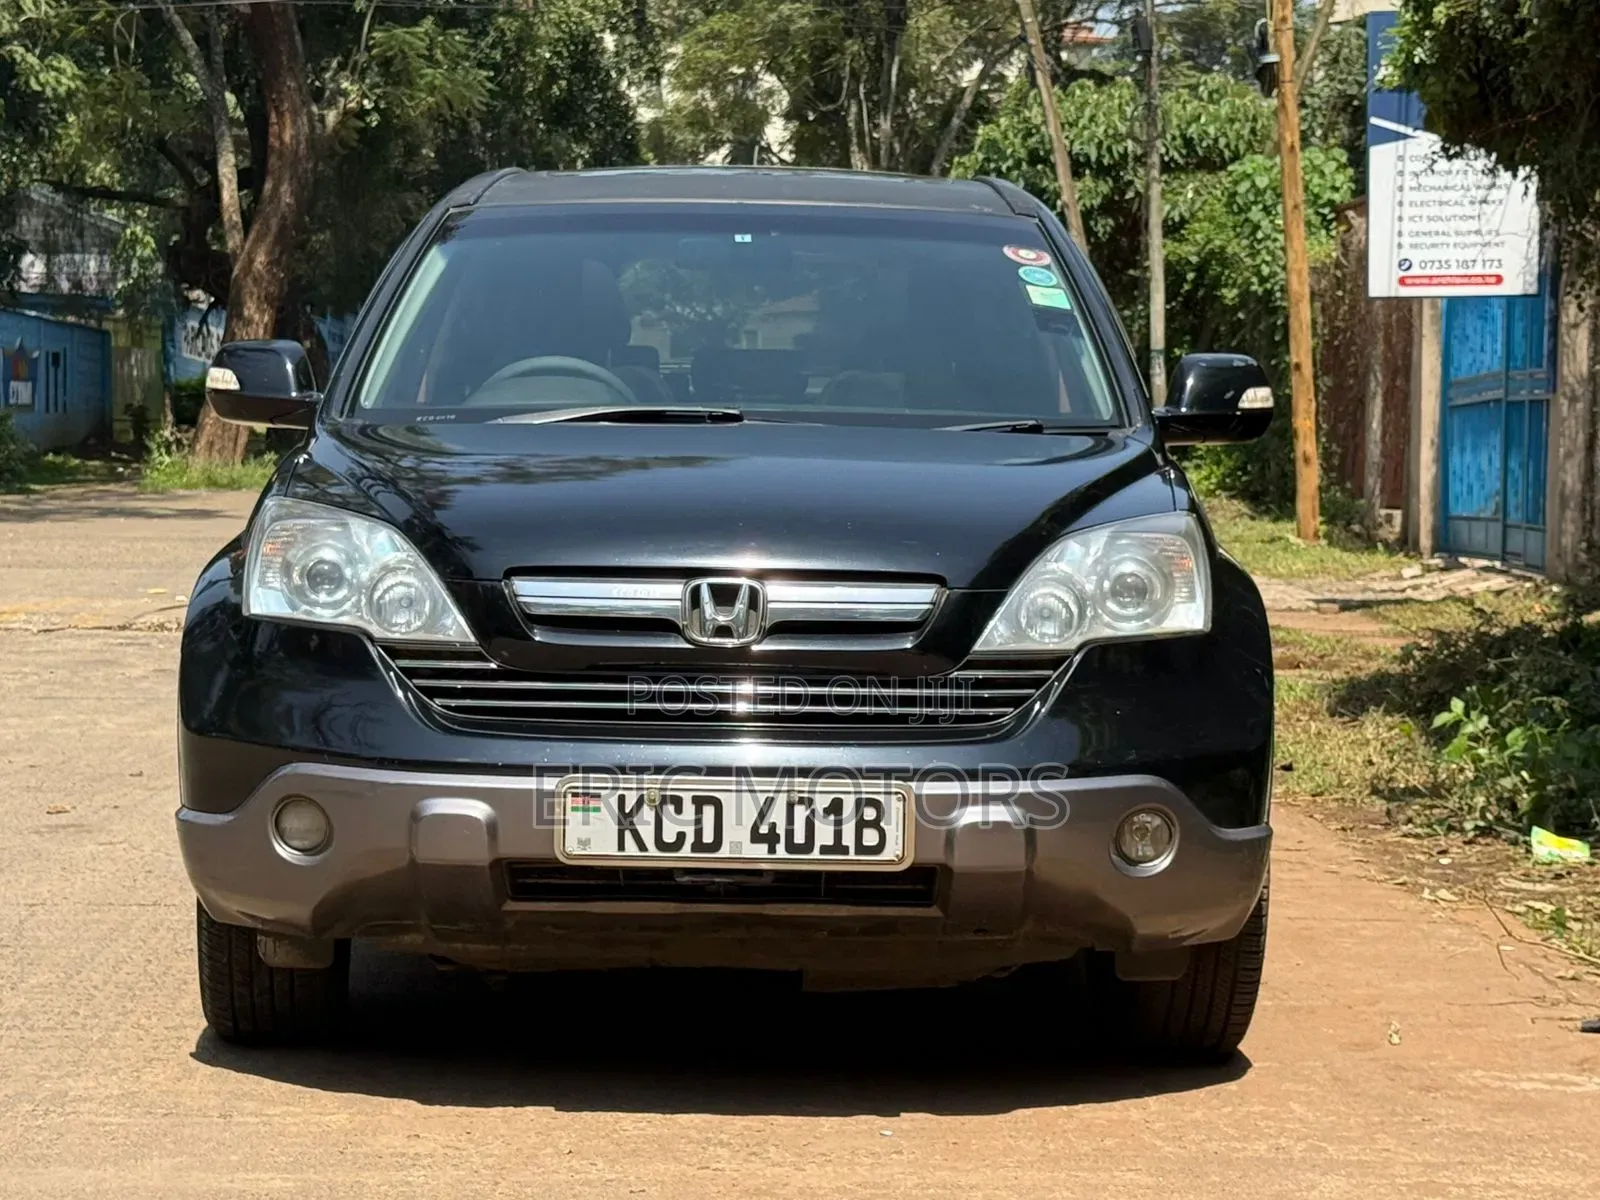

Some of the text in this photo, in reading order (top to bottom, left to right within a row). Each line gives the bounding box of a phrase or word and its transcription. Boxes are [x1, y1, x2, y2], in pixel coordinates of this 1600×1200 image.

[1408, 199, 1465, 208] ELECTRICAL
[1408, 214, 1423, 223] ICT
[1408, 230, 1451, 238] GENERAL
[1409, 241, 1450, 250] SECURITY
[1418, 258, 1503, 270] 0735 187 173
[617, 792, 724, 853] KCD
[750, 795, 887, 856] 401B
